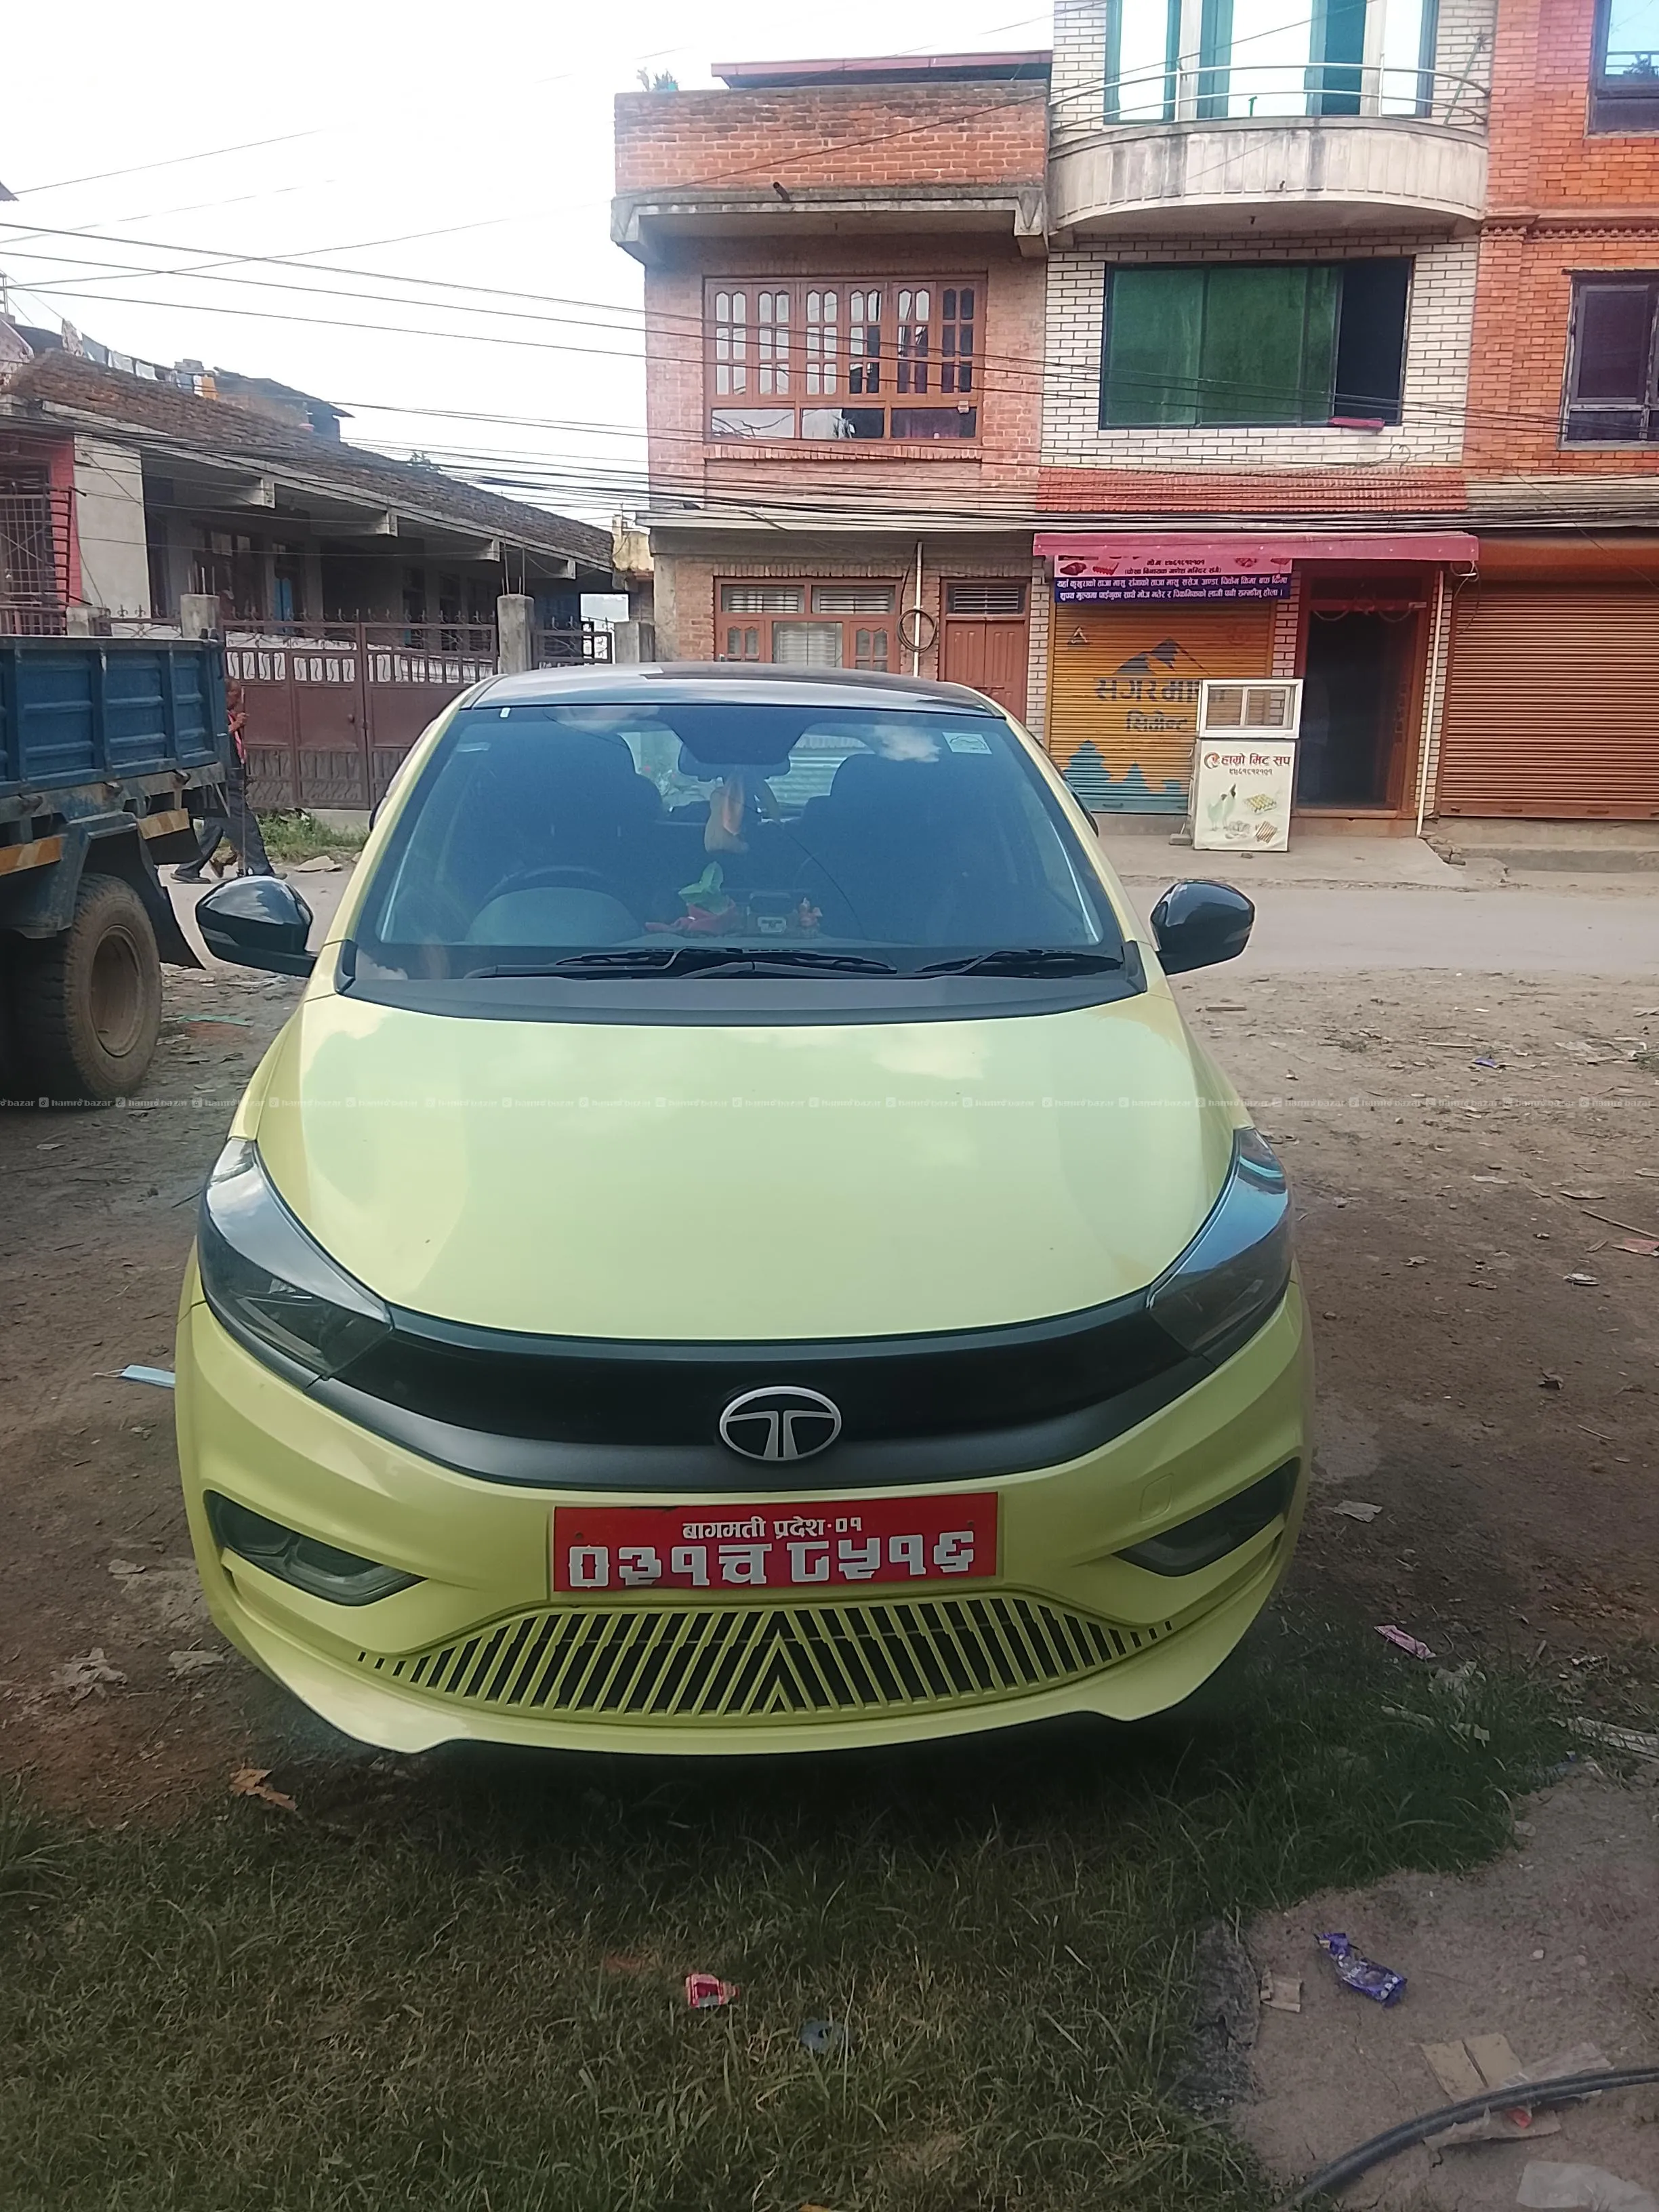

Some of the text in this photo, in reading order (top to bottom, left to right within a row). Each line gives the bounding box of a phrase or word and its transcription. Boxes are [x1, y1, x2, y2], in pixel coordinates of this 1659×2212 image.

[1113, 580, 1126, 588] मासु
[1166, 579, 1179, 587] मासु
[1221, 752, 1246, 765] हाम्रो
[1249, 752, 1270, 765] मिट
[682, 1516, 766, 1539] बागमती
